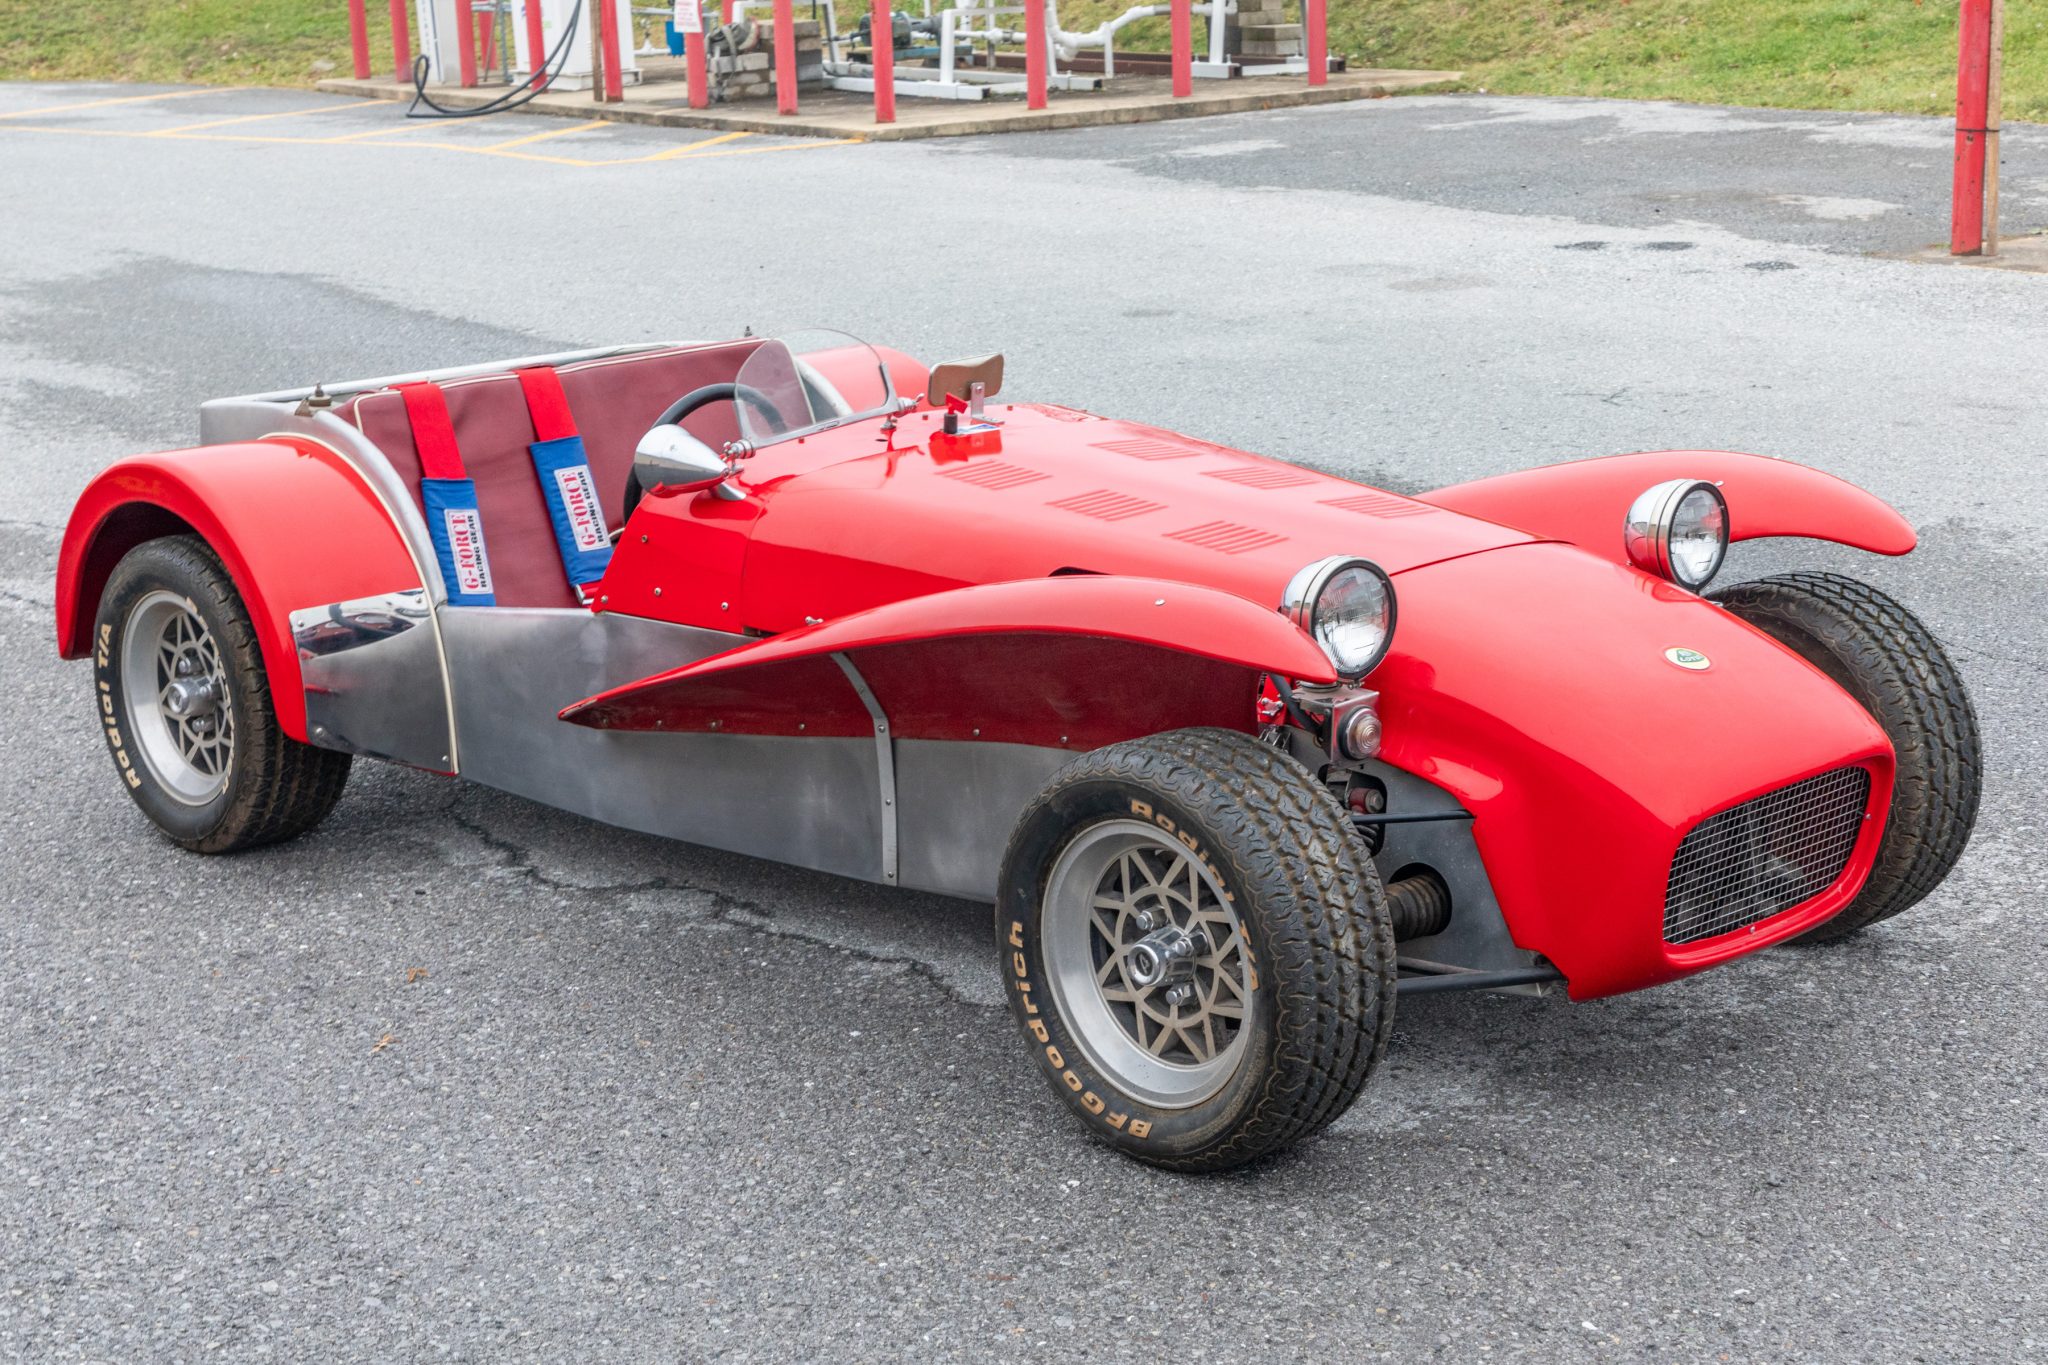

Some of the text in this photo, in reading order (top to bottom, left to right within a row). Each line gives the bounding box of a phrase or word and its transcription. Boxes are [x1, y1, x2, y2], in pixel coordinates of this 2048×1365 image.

[562, 472, 596, 546] G-FORCE
[577, 471, 604, 542] RACING GEAR
[452, 514, 479, 589] G-FORCE
[467, 515, 487, 588] RACING GEAR
[98, 624, 141, 789] Radial T/A
[1131, 799, 1235, 902] Radial
[1009, 921, 1152, 1139] BFGoodrich
